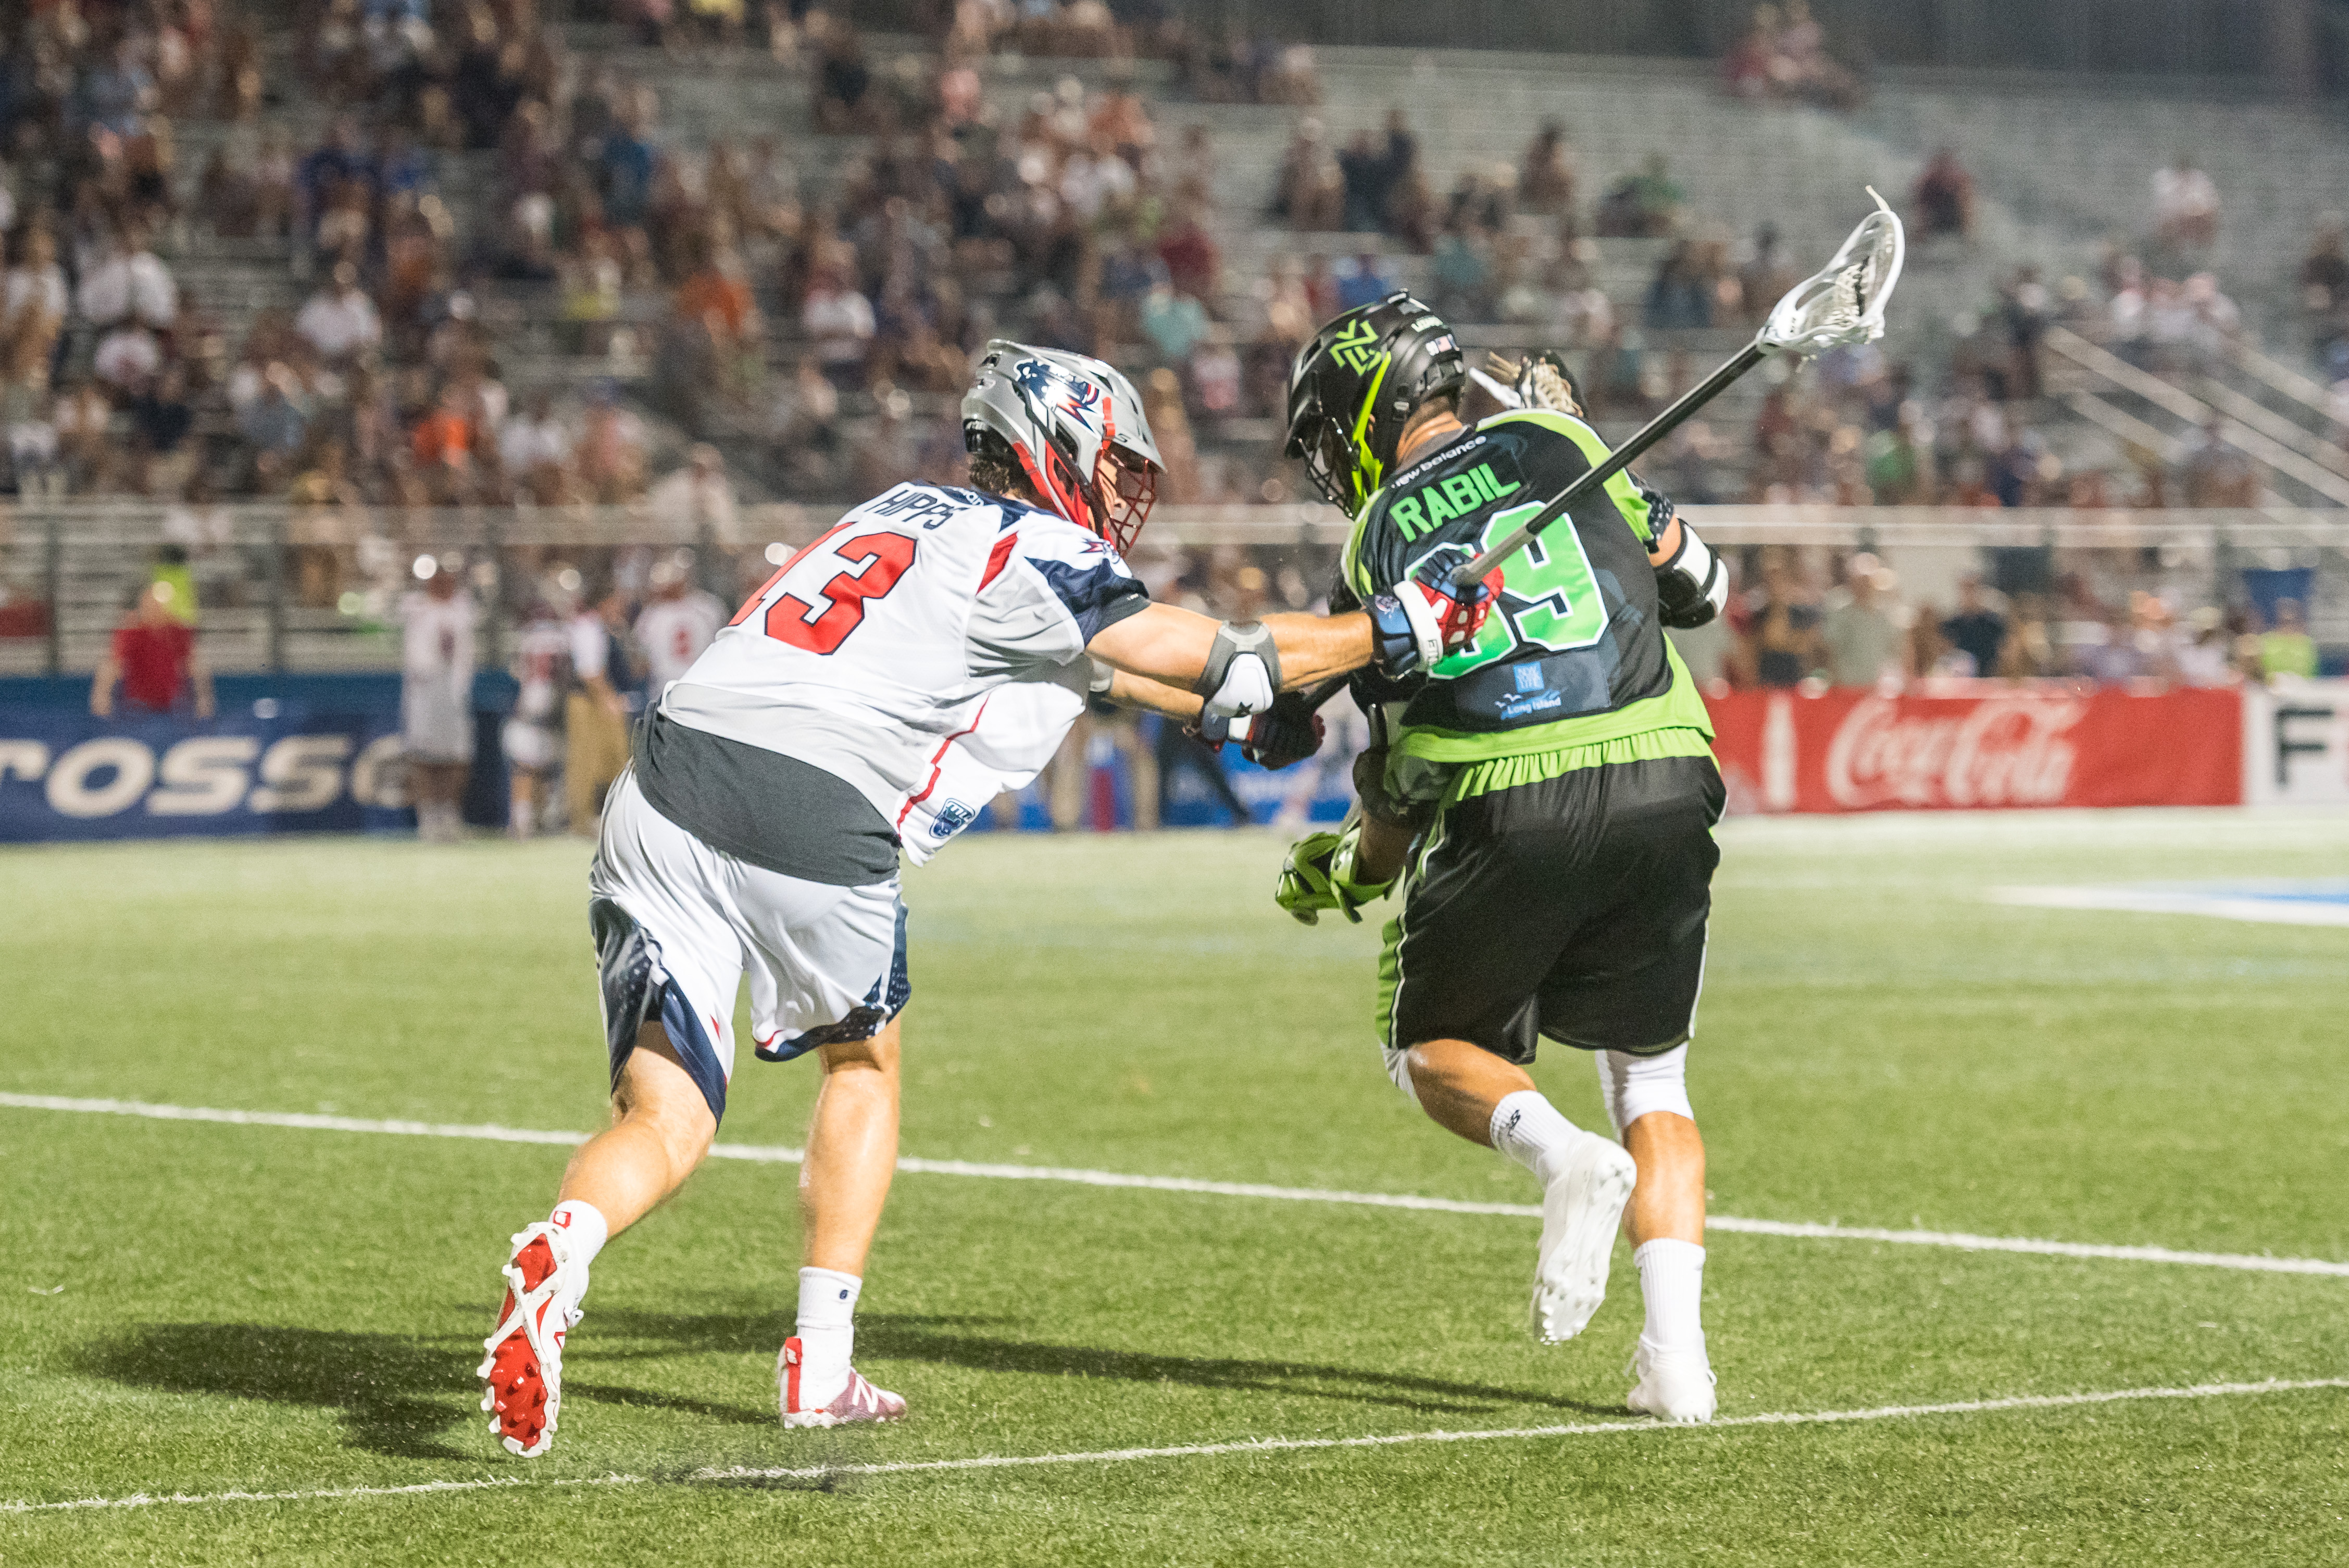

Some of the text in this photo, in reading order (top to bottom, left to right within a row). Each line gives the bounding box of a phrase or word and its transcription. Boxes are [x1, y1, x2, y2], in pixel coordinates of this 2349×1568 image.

[1419, 435, 1486, 472] balance
[1389, 462, 1521, 543] RABIL
[1507, 696, 1561, 714] Long Island
